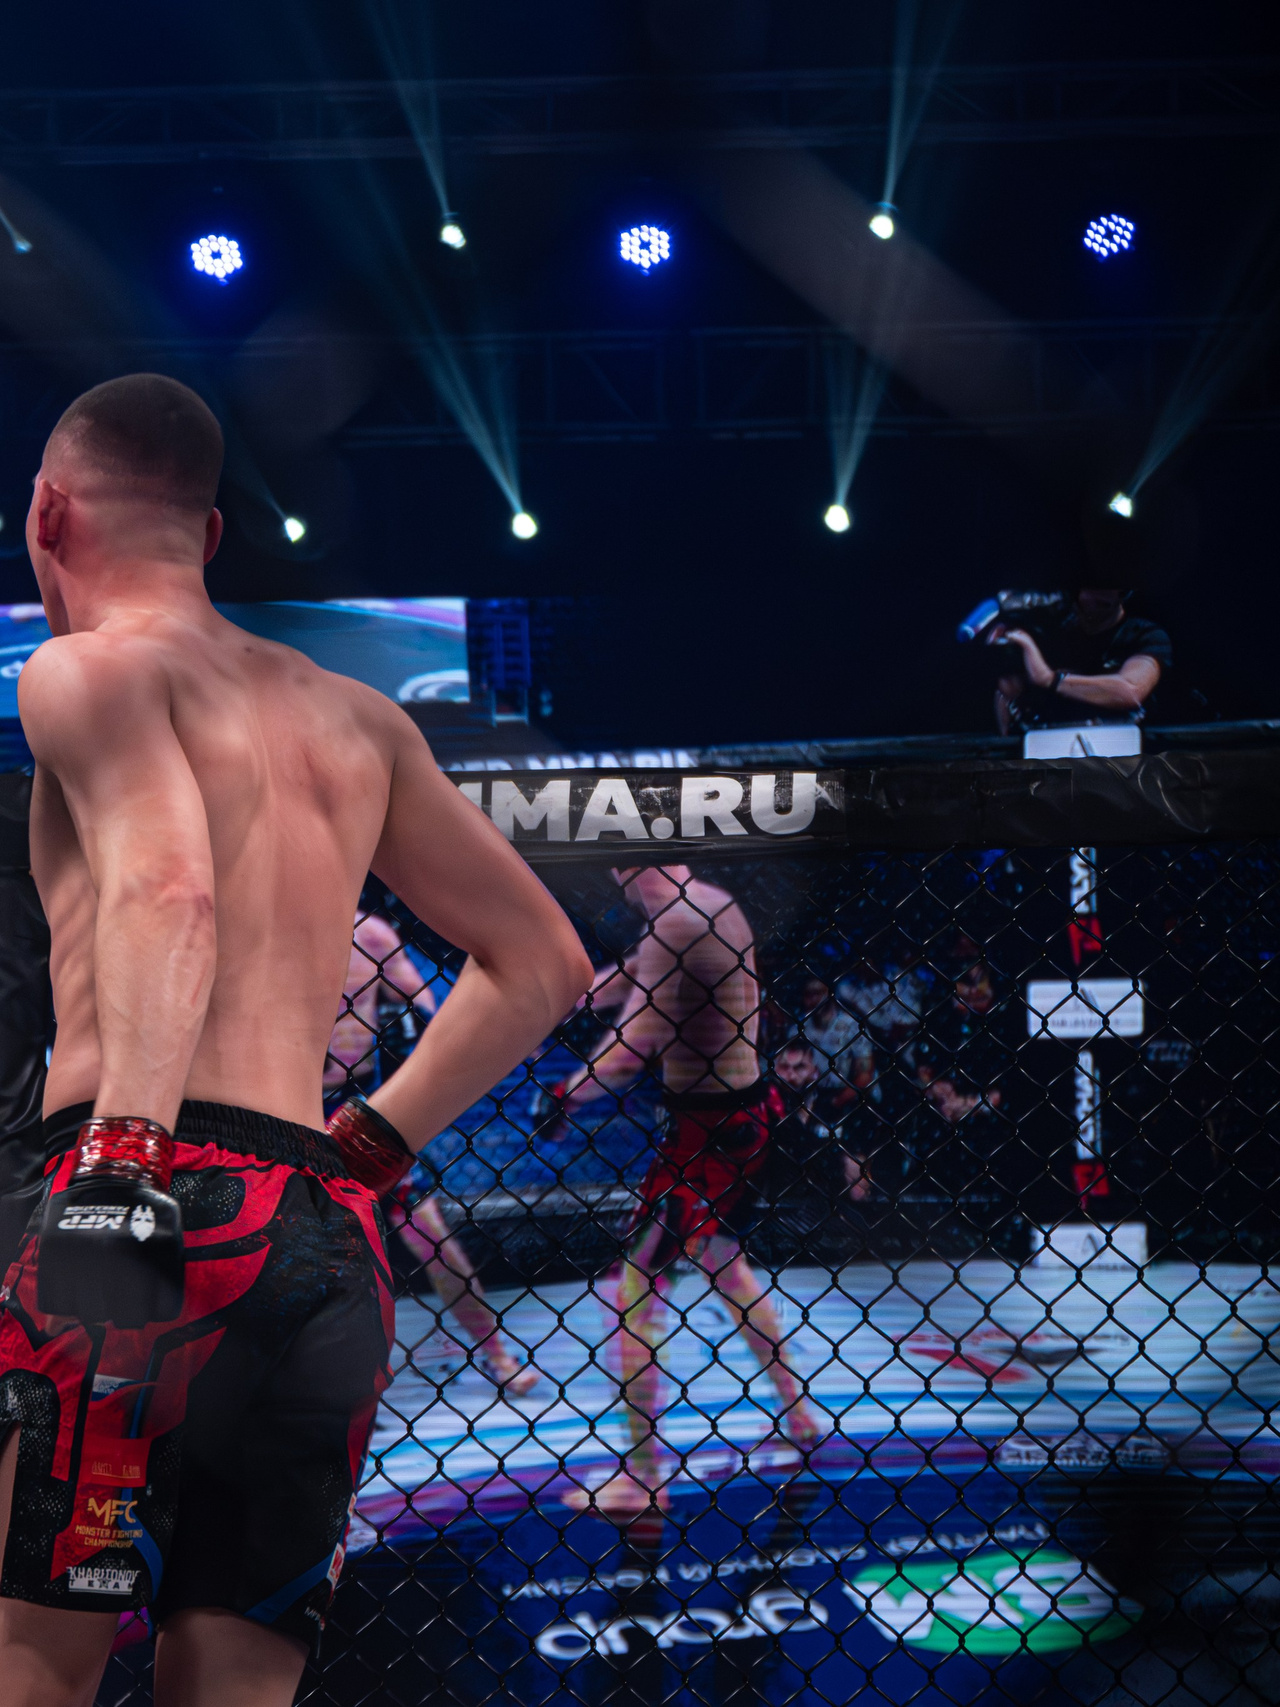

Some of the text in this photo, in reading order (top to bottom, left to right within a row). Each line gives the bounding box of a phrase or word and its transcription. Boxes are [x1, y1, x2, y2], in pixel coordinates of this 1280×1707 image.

[458, 772, 816, 842] MA.RU
[58, 1215, 125, 1230] MFP
[87, 1497, 138, 1526] MFC
